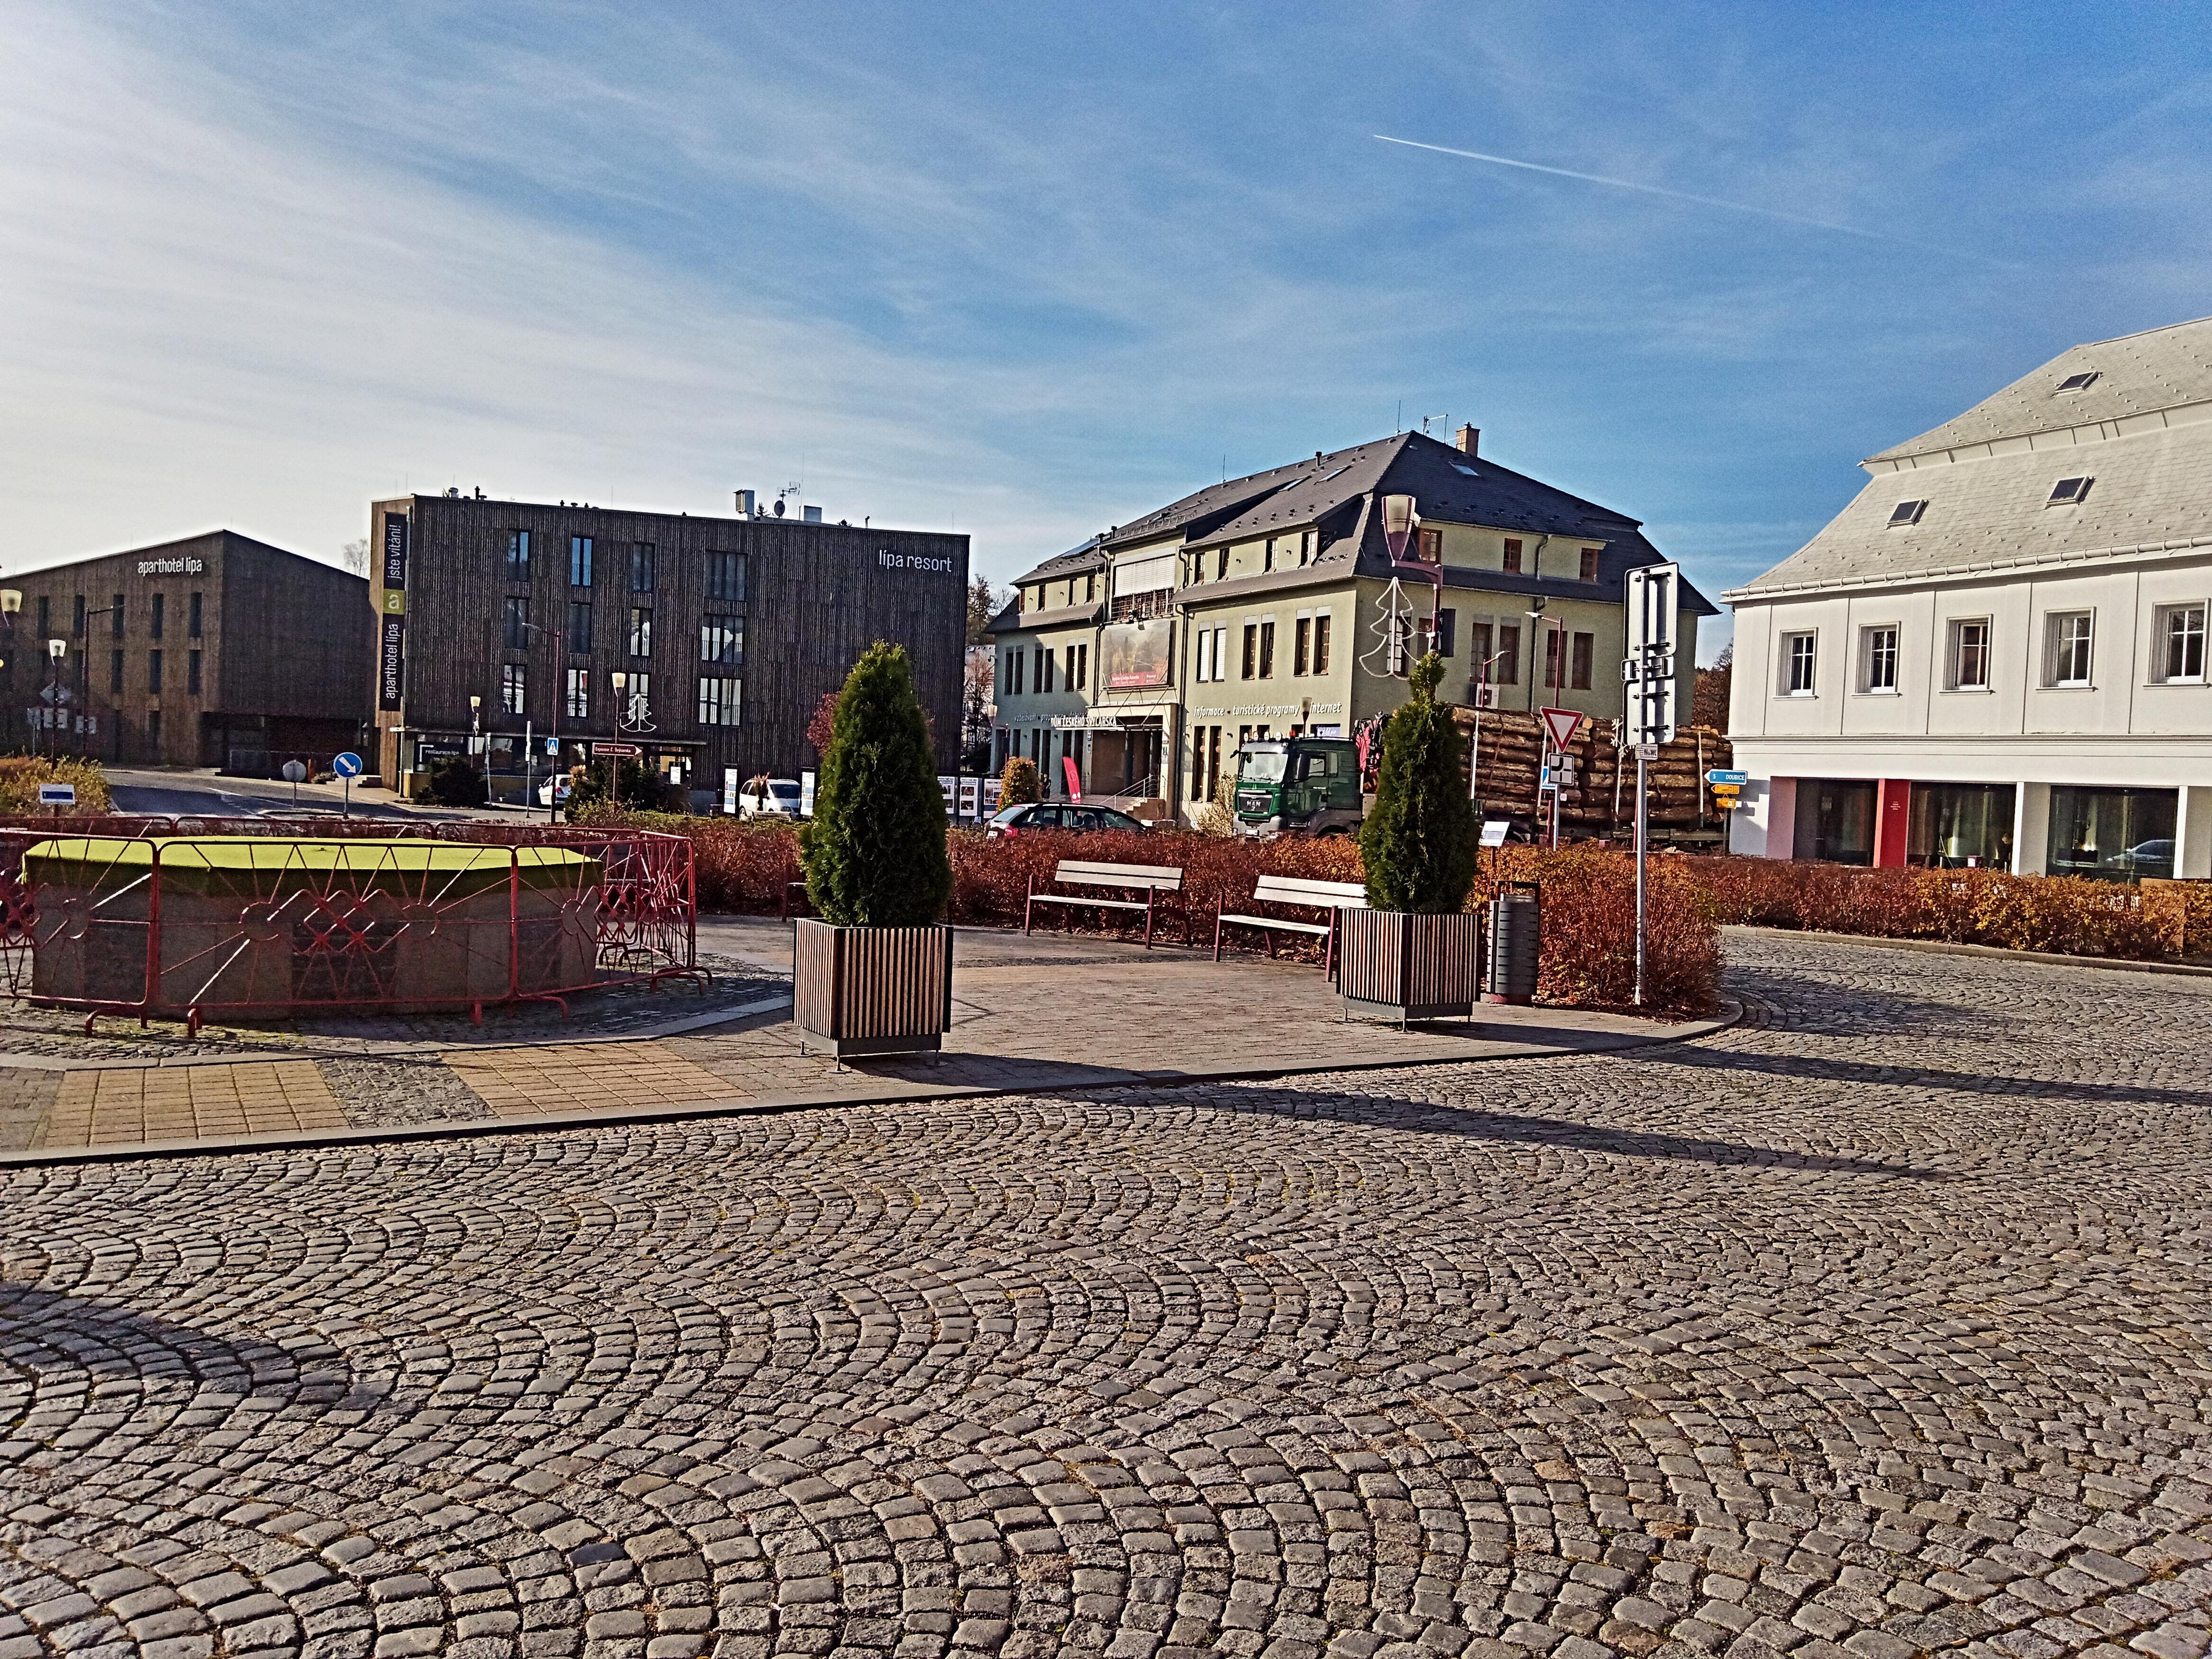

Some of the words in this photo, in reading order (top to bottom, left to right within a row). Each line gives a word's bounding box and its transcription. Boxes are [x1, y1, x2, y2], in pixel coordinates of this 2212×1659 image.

[138, 557, 184, 577] aparthotel
[185, 556, 202, 575] lípa
[388, 559, 403, 581] jste
[879, 550, 904, 570] lípa
[907, 556, 952, 572] resort
[385, 624, 401, 642] lípa
[384, 645, 399, 699] aparthotel
[1194, 706, 1225, 719] informace
[1233, 703, 1265, 716] turistické
[1265, 705, 1300, 717] programy
[1310, 702, 1342, 714] internet
